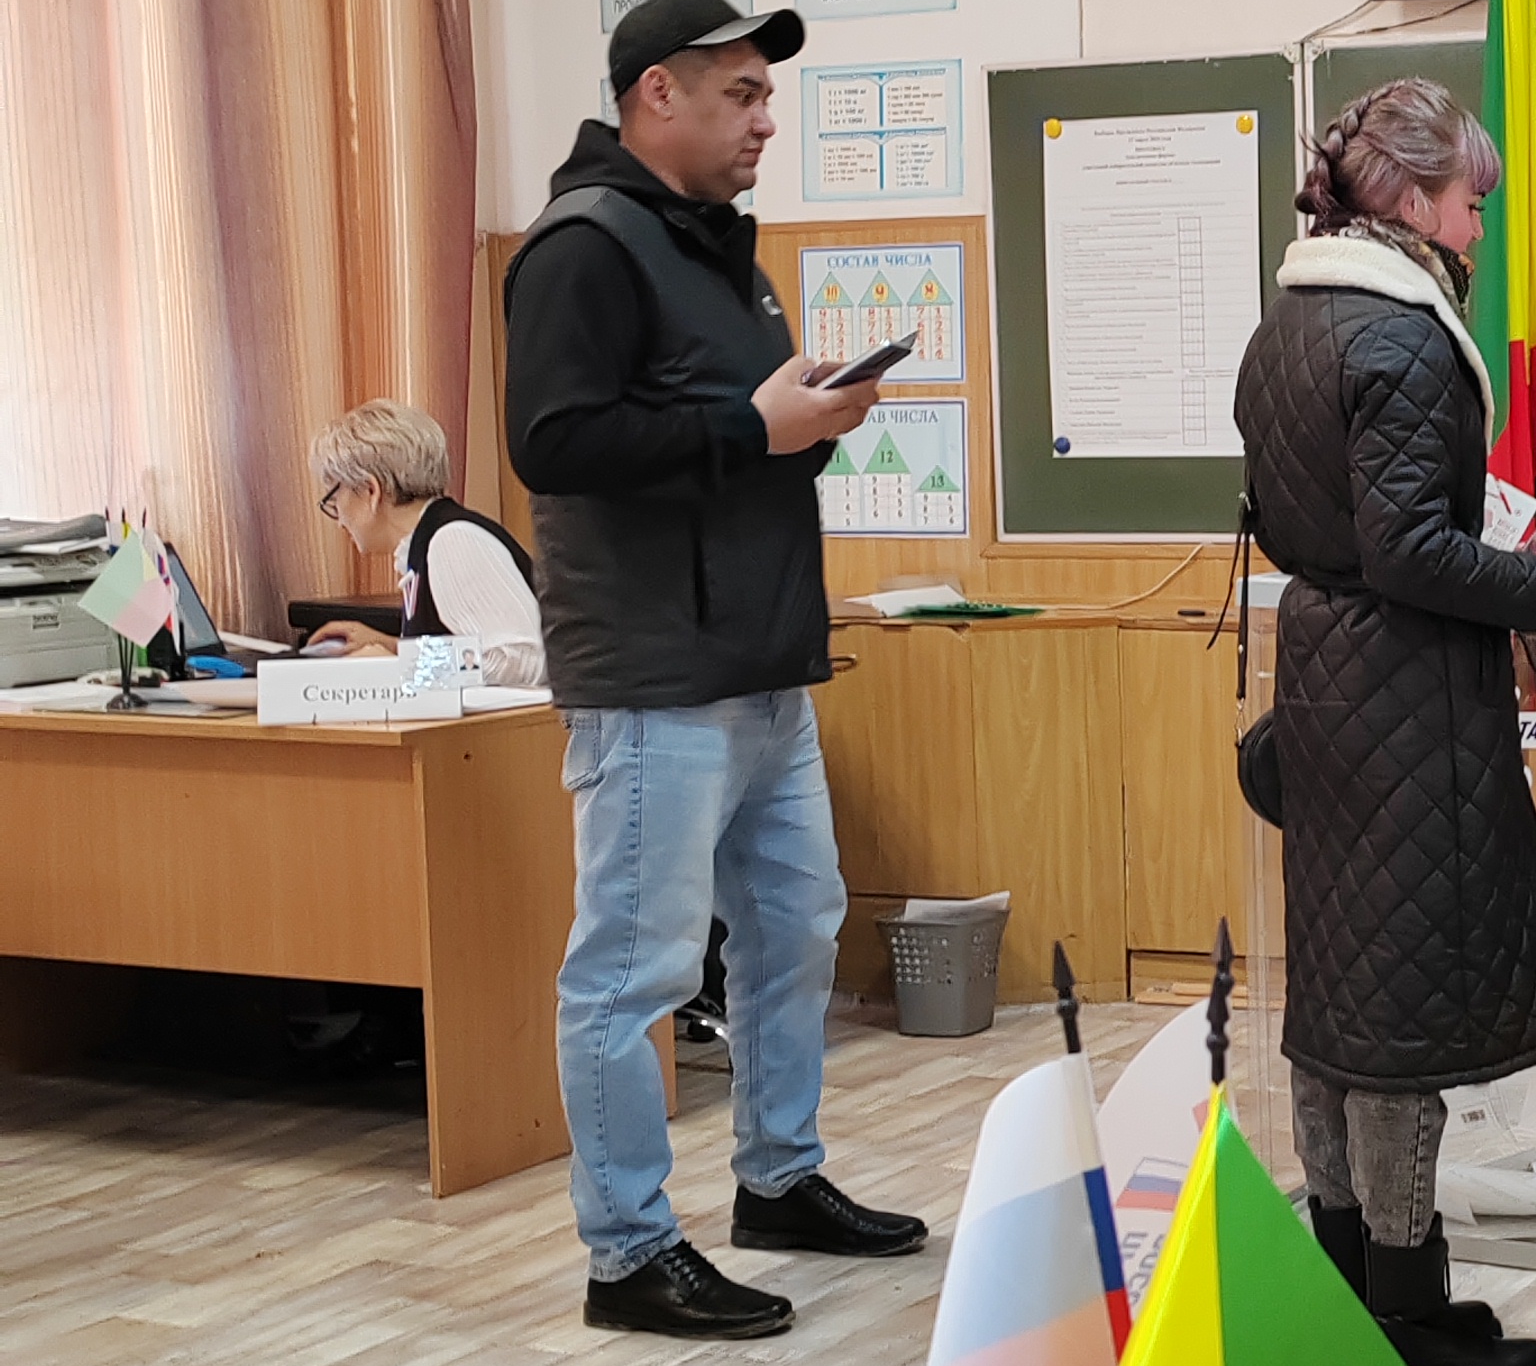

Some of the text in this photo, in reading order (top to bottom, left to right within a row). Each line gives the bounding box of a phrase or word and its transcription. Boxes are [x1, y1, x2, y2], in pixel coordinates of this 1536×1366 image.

[827, 253, 932, 269] СОСТАВ ЧИСЛА
[890, 409, 939, 424] ЧИСЛА
[881, 451, 893, 463] 12
[931, 476, 944, 488] 13
